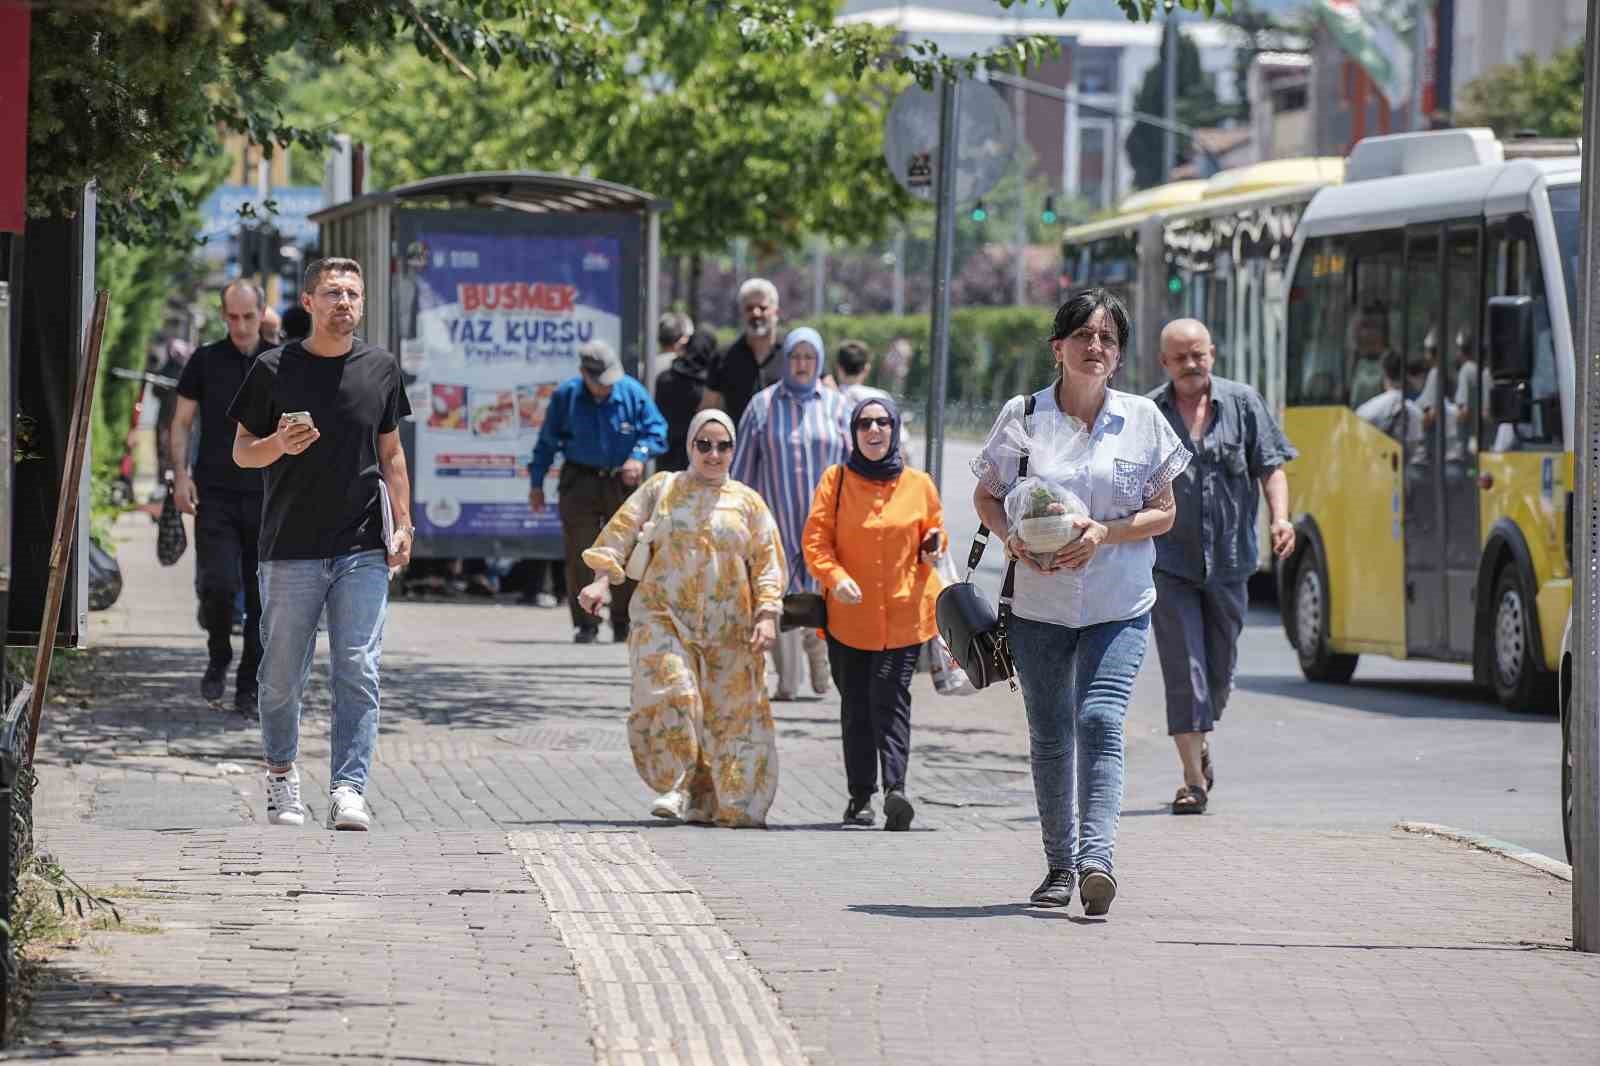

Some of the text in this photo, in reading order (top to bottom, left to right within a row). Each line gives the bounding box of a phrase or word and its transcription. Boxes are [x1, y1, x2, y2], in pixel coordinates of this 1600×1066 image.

[459, 283, 577, 313] BUSMEK
[447, 319, 594, 344] YAZ KURSU
